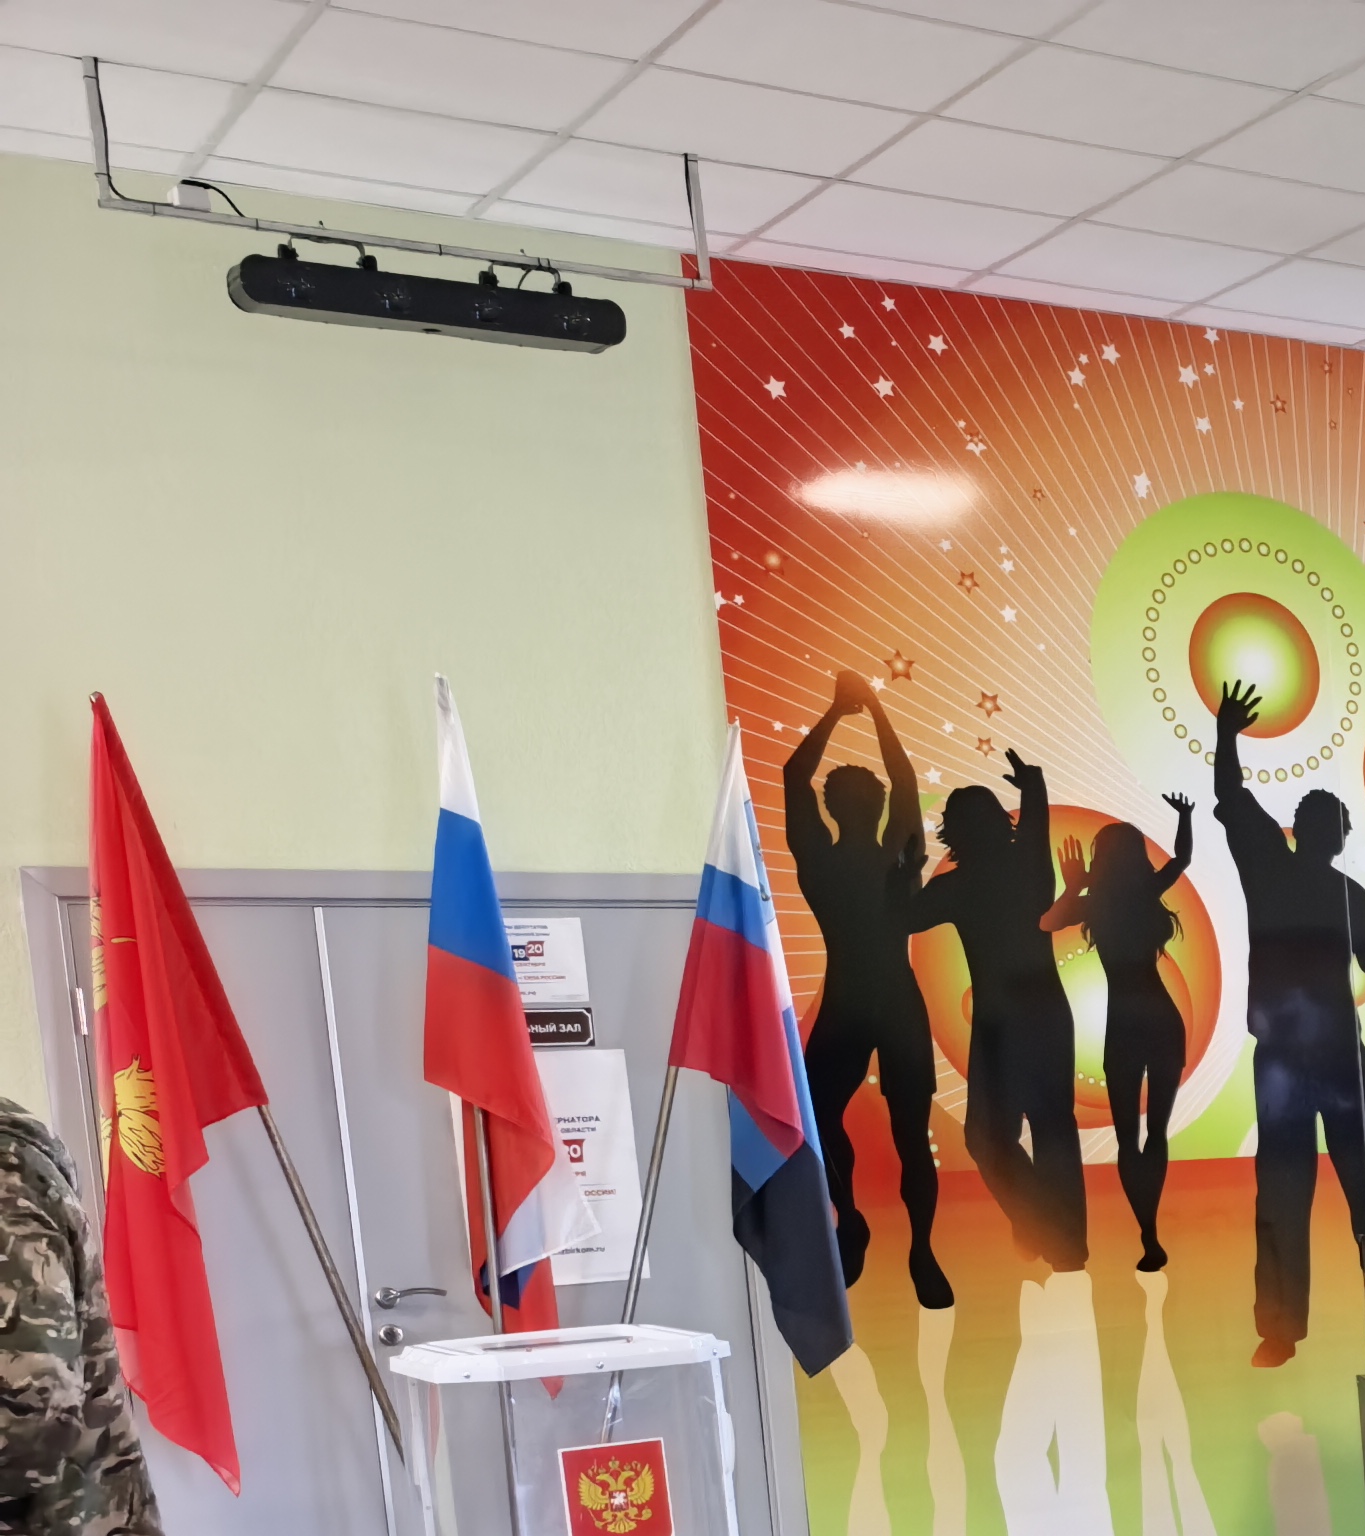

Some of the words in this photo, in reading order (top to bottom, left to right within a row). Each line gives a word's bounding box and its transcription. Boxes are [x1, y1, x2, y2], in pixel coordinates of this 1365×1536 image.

[512, 948, 526, 959] 19
[527, 943, 543, 954] 20
[559, 1023, 582, 1032] ЗАЛ
[556, 1115, 601, 1124] РНАТОРА
